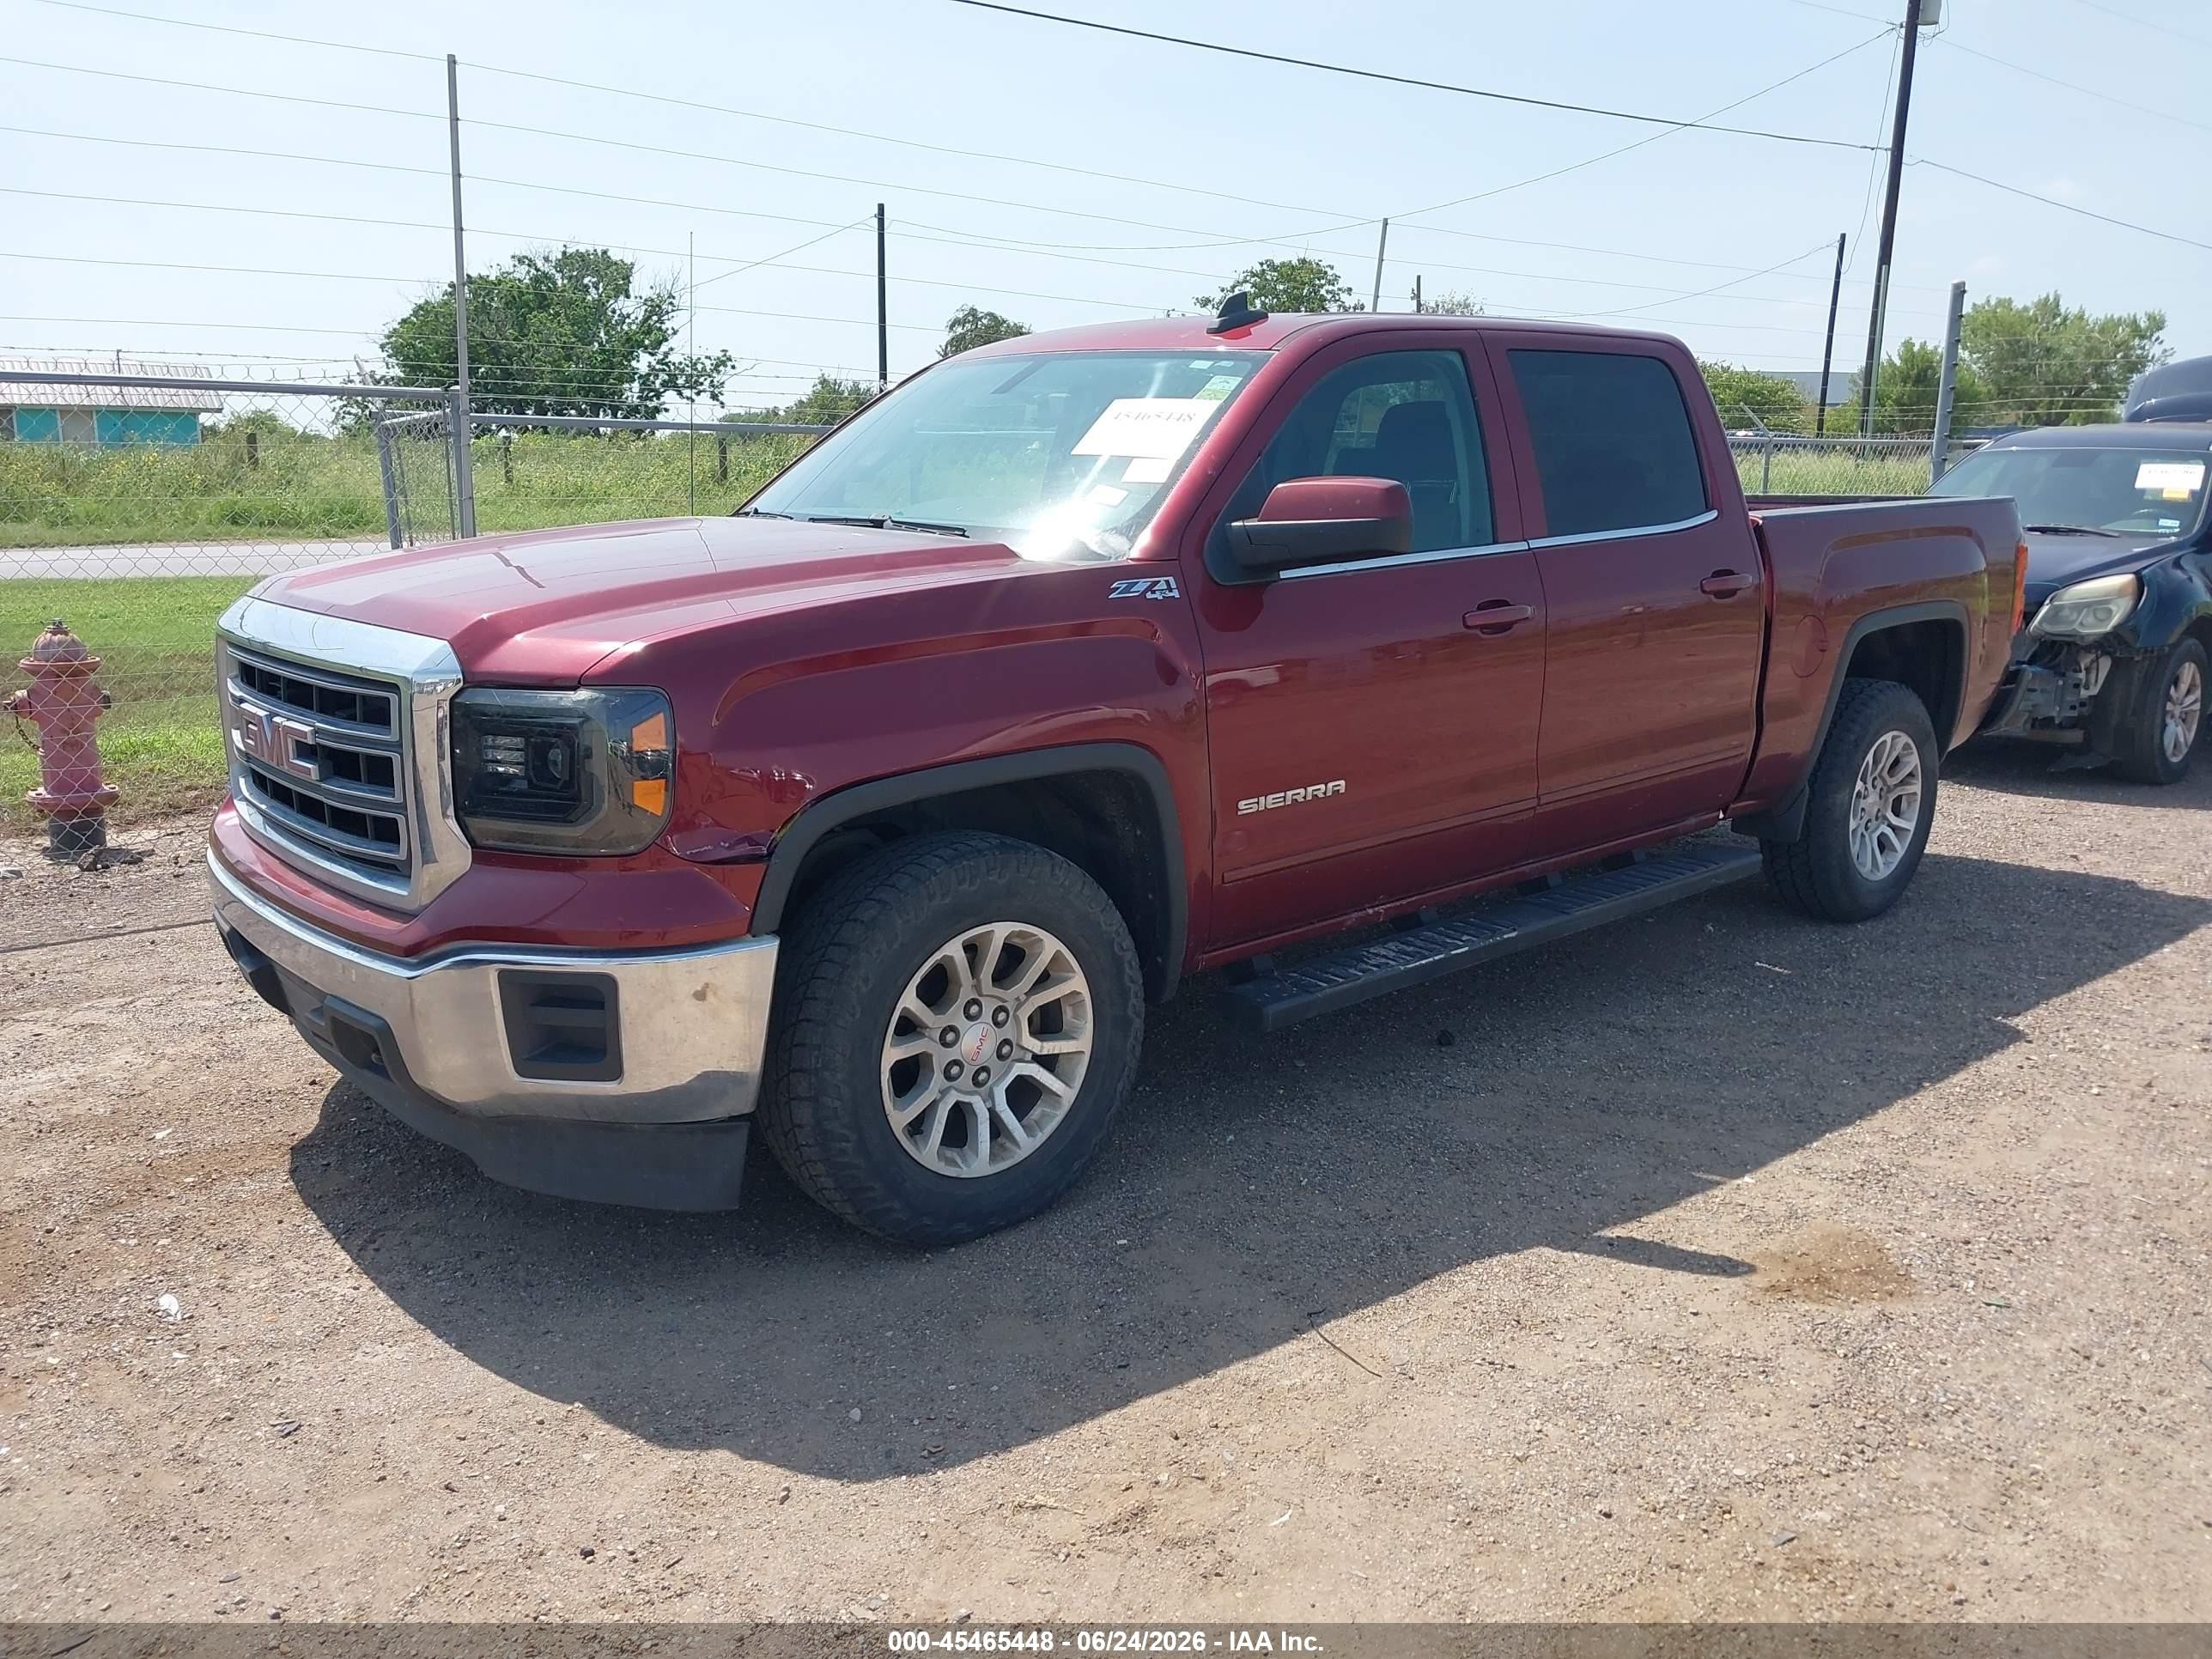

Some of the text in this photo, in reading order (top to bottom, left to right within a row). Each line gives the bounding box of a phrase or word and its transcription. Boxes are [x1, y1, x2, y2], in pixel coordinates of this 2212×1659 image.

[240, 702, 320, 781] GMC
[1237, 779, 1346, 816] SIERRA
[971, 1026, 989, 1062] GMC
